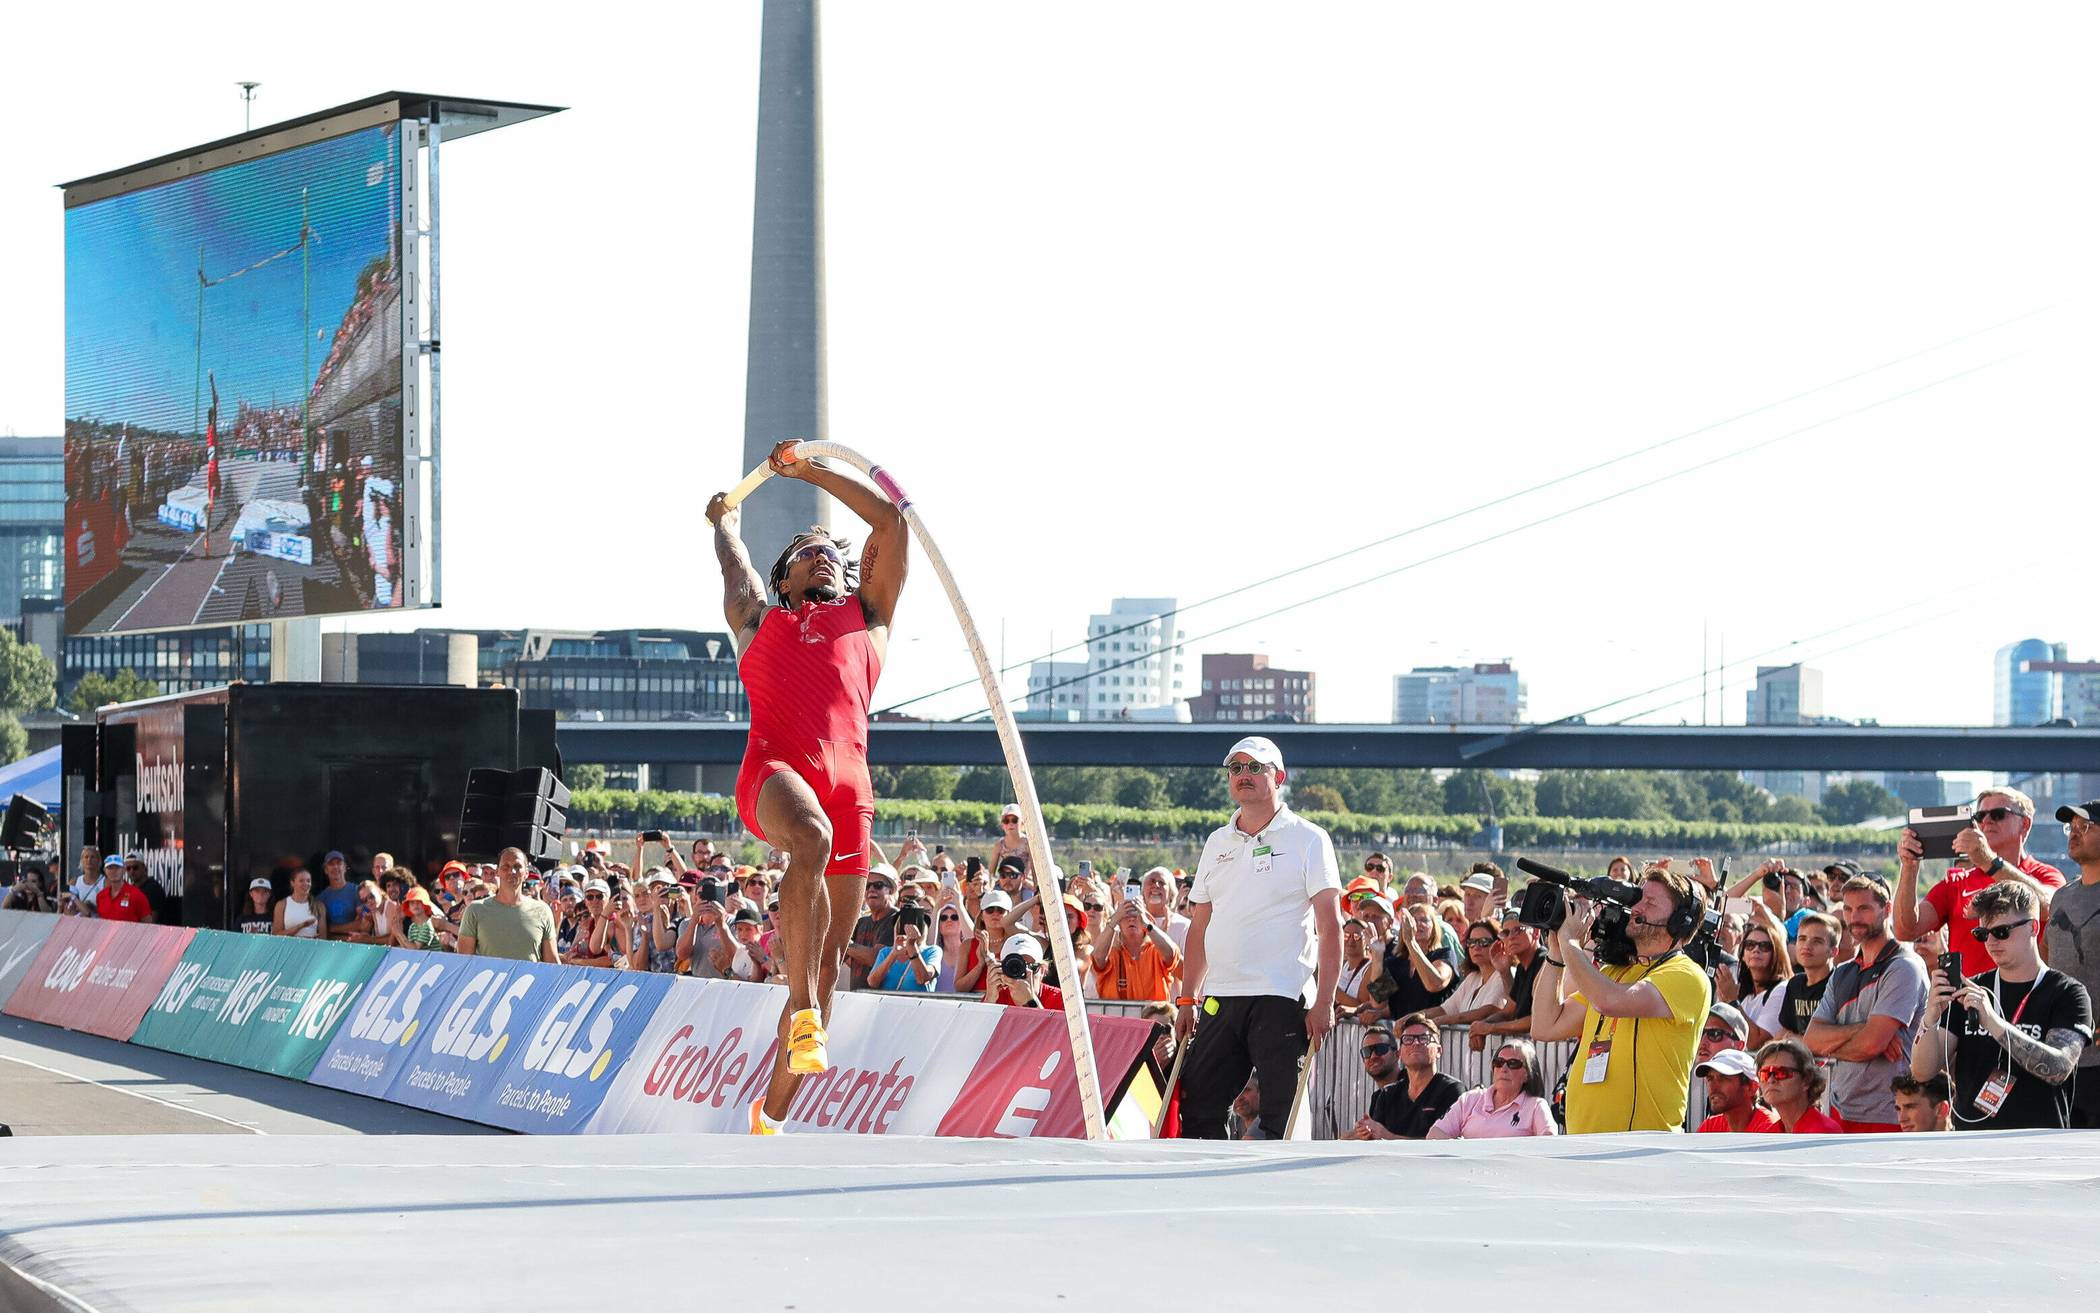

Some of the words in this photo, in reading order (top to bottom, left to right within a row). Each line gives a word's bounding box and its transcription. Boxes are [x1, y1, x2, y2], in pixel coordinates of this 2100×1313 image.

[153, 960, 212, 1015] WGV
[215, 968, 282, 1027] WGV
[287, 977, 363, 1041] WGV
[327, 1049, 356, 1072] Parcels
[358, 1054, 384, 1082] People
[406, 1065, 437, 1089] Parcels
[432, 1070, 446, 1091] to
[440, 1071, 472, 1101] People
[643, 1024, 749, 1108] Große
[732, 1037, 915, 1135] Mmente
[496, 1083, 531, 1109] Parcels
[526, 1088, 541, 1111] to
[535, 1089, 571, 1122] People
